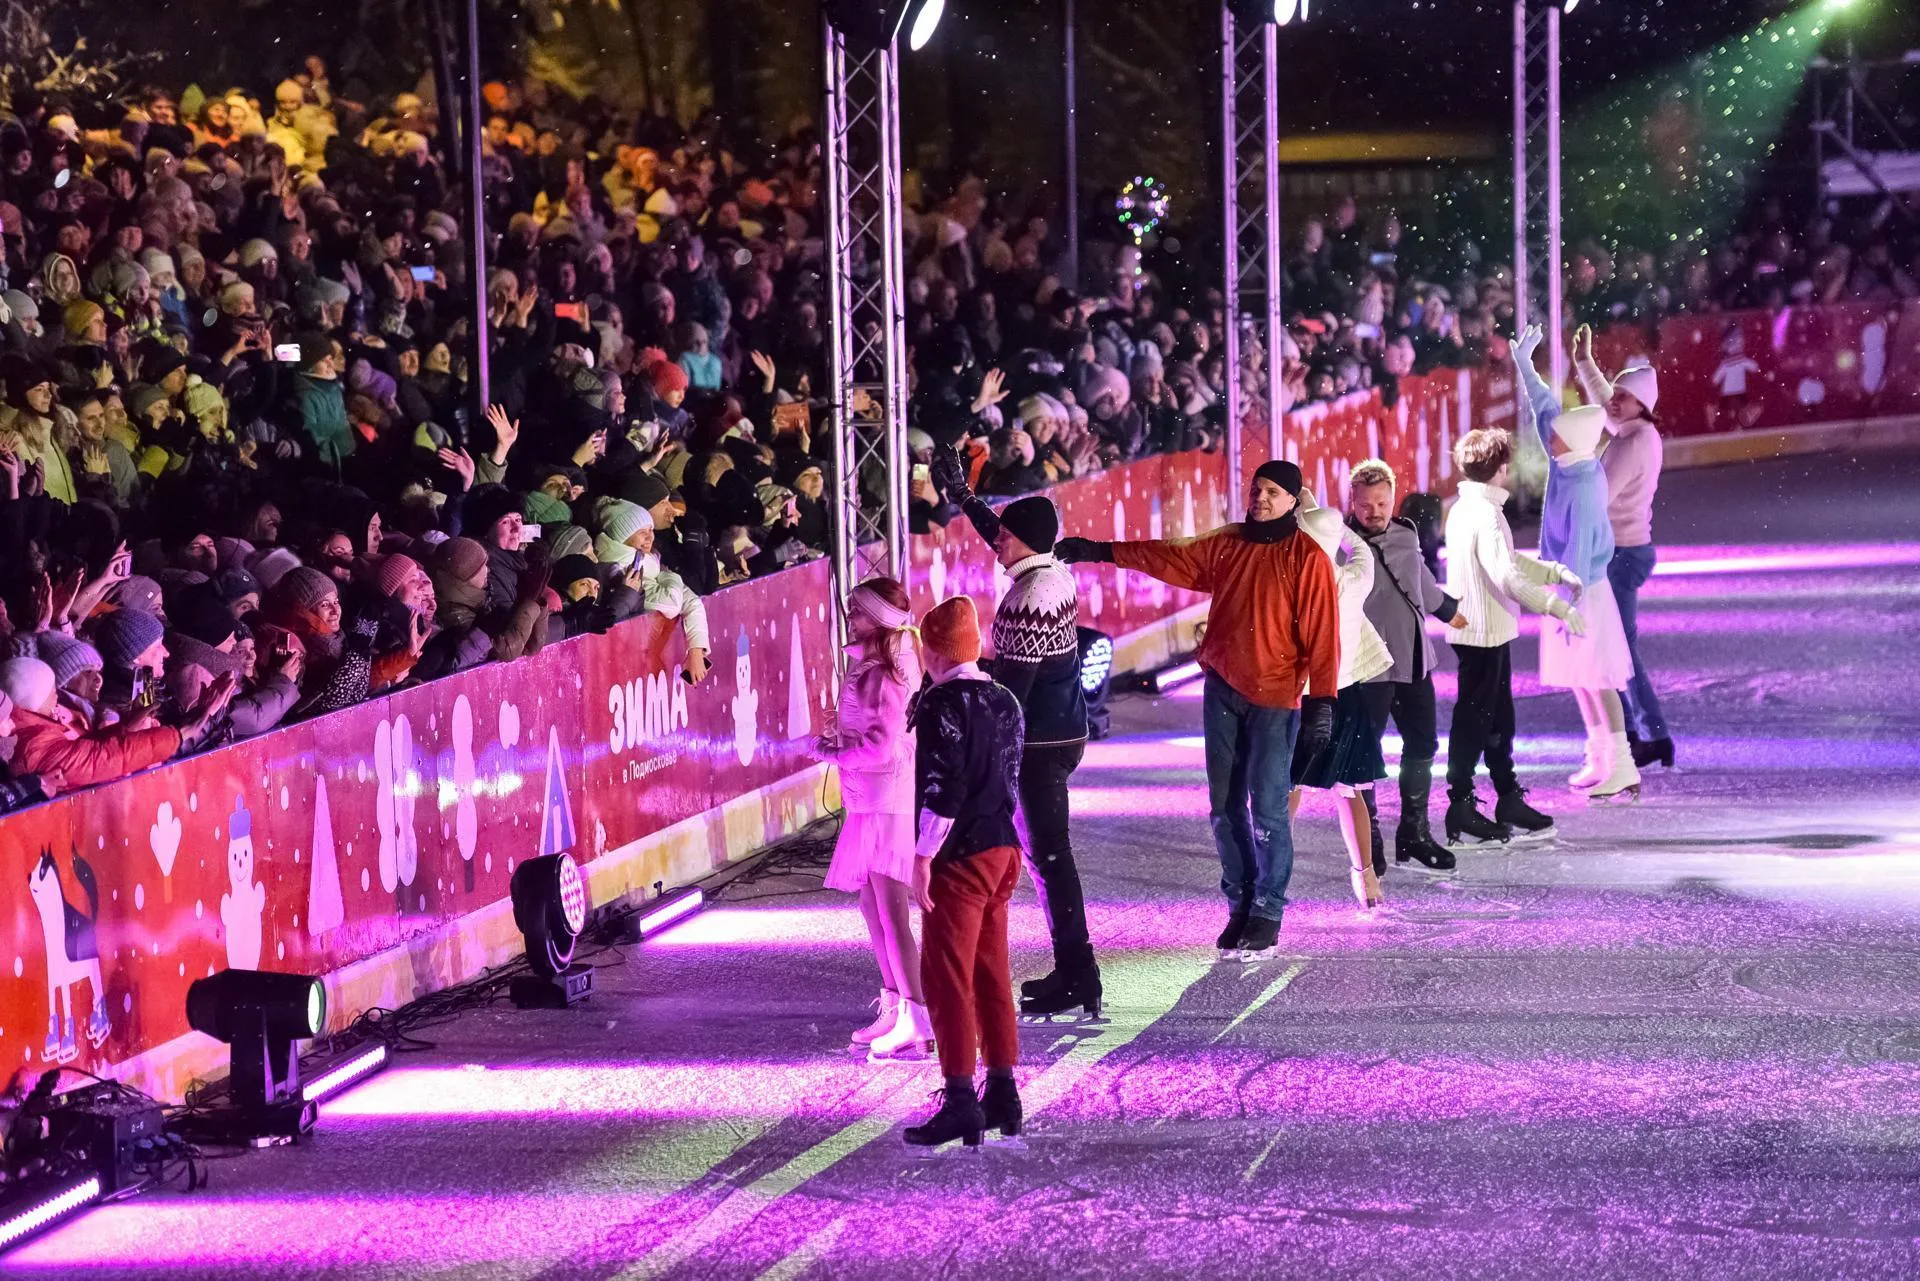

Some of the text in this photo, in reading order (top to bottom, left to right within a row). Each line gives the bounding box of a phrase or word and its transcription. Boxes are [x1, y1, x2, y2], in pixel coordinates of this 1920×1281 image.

[609, 664, 688, 754] ЗИМА
[622, 751, 677, 784] в Подмосковье
